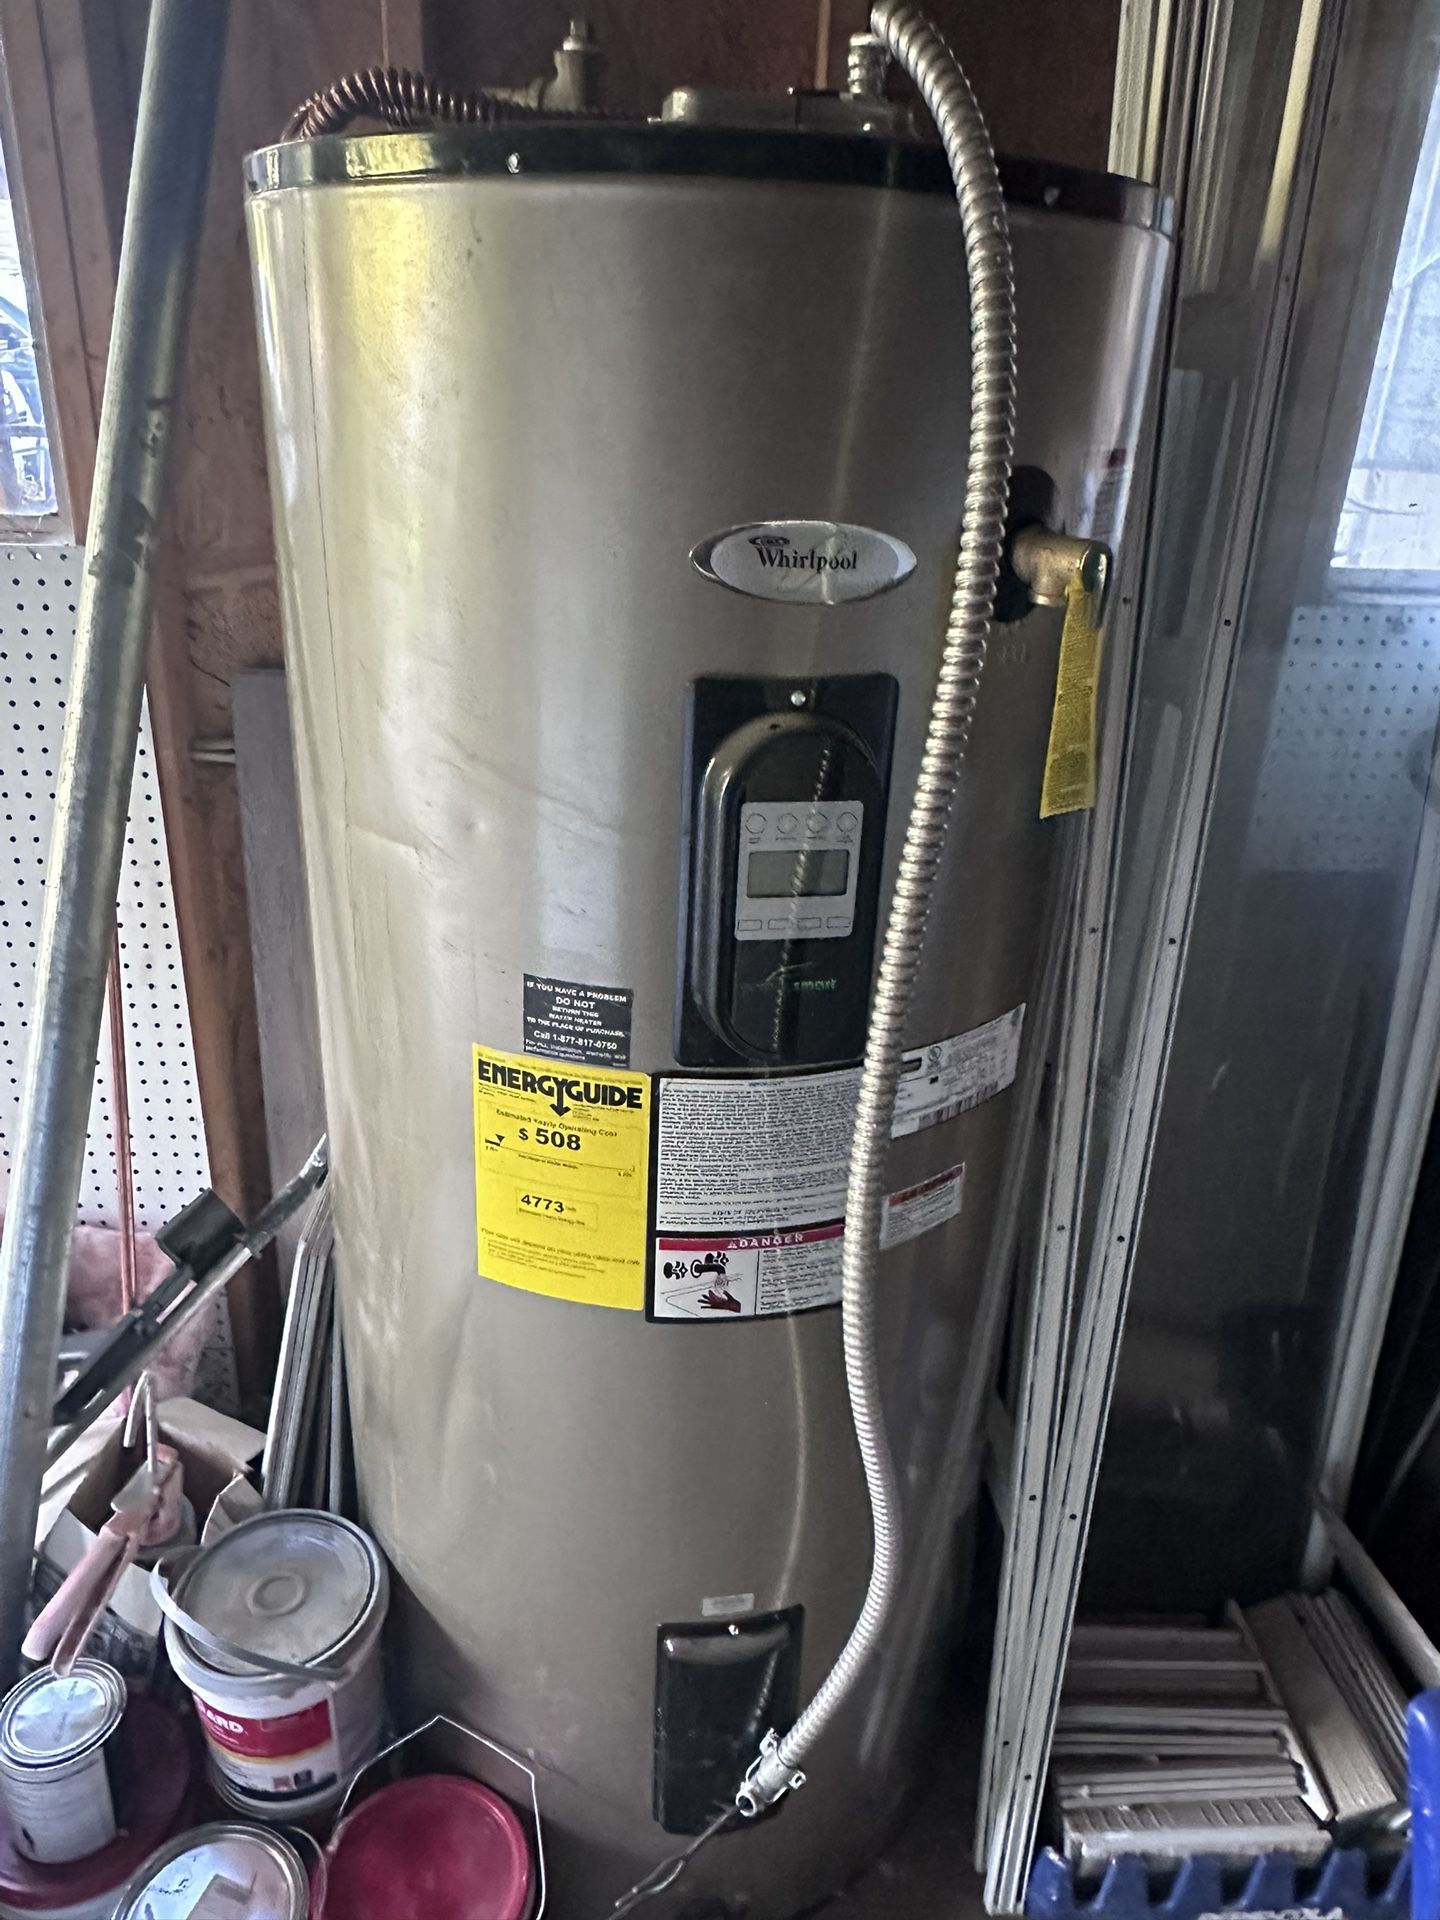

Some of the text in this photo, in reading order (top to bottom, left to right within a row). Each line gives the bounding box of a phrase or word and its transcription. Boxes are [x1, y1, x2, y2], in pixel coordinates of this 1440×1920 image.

[756, 547, 858, 574] Whirlpool
[536, 983, 553, 992] YOU
[554, 986, 577, 996] HAVE
[578, 989, 585, 997] A
[587, 992, 627, 1003] PROBLEM
[552, 1005, 580, 1016] RETURN
[556, 996, 596, 1009] DO NOT
[537, 1018, 551, 1026] THE
[551, 1021, 573, 1031] PLACE
[549, 1013, 602, 1027] WATER HEATER
[533, 1030, 551, 1040] Call
[478, 1058, 643, 1113] ENERGYGUIDE
[558, 1122, 597, 1136] Operating
[598, 1128, 618, 1137] Cost
[518, 1127, 582, 1151] $ 508
[520, 1194, 565, 1213] 4773
[738, 1231, 805, 1249] DANGER
